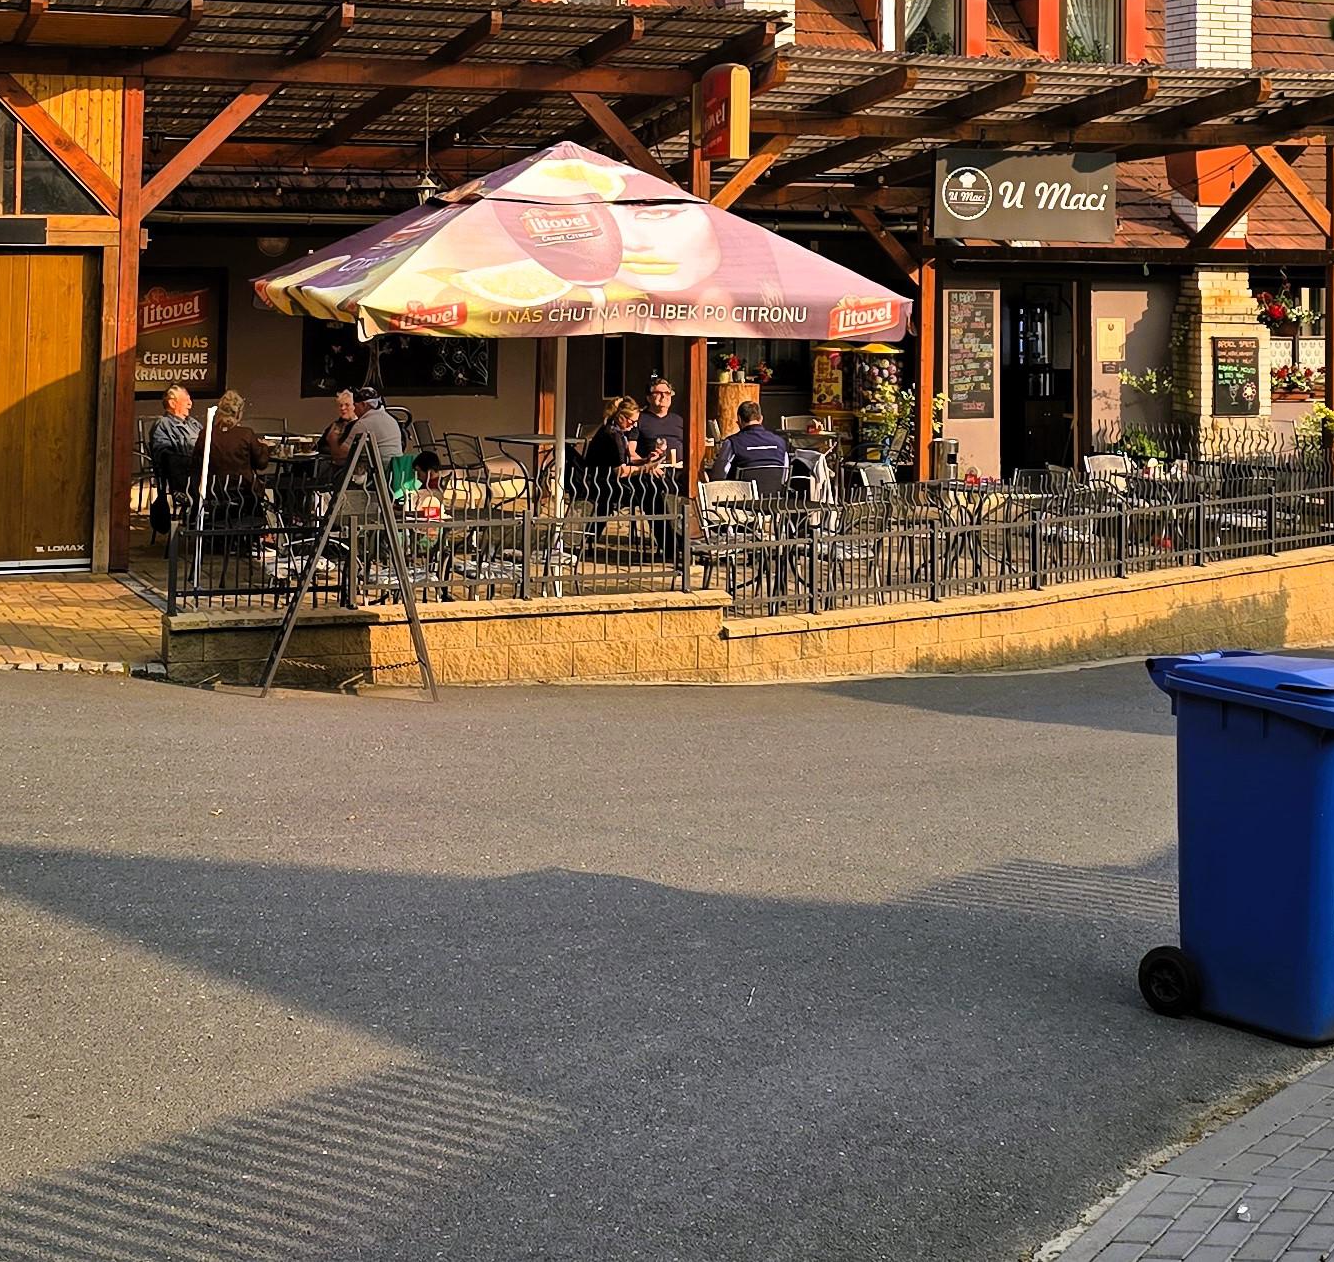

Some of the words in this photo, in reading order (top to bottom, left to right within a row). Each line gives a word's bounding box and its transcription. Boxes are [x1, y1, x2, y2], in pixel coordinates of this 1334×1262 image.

[948, 191, 959, 202] U
[960, 192, 987, 202] Maci
[998, 180, 1027, 209] U
[1034, 181, 1110, 211] Maci
[142, 295, 201, 329] Litovel
[488, 311, 502, 324] U
[506, 307, 544, 324] NÁS
[624, 303, 699, 320] POLIBEK
[703, 305, 728, 322] PO
[730, 306, 808, 323] CITRONU
[837, 301, 893, 333] Litovel
[171, 337, 181, 348] U
[182, 335, 209, 348] NÁS
[143, 350, 208, 365] ČEPUJEME
[47, 544, 85, 552] LOMAX
